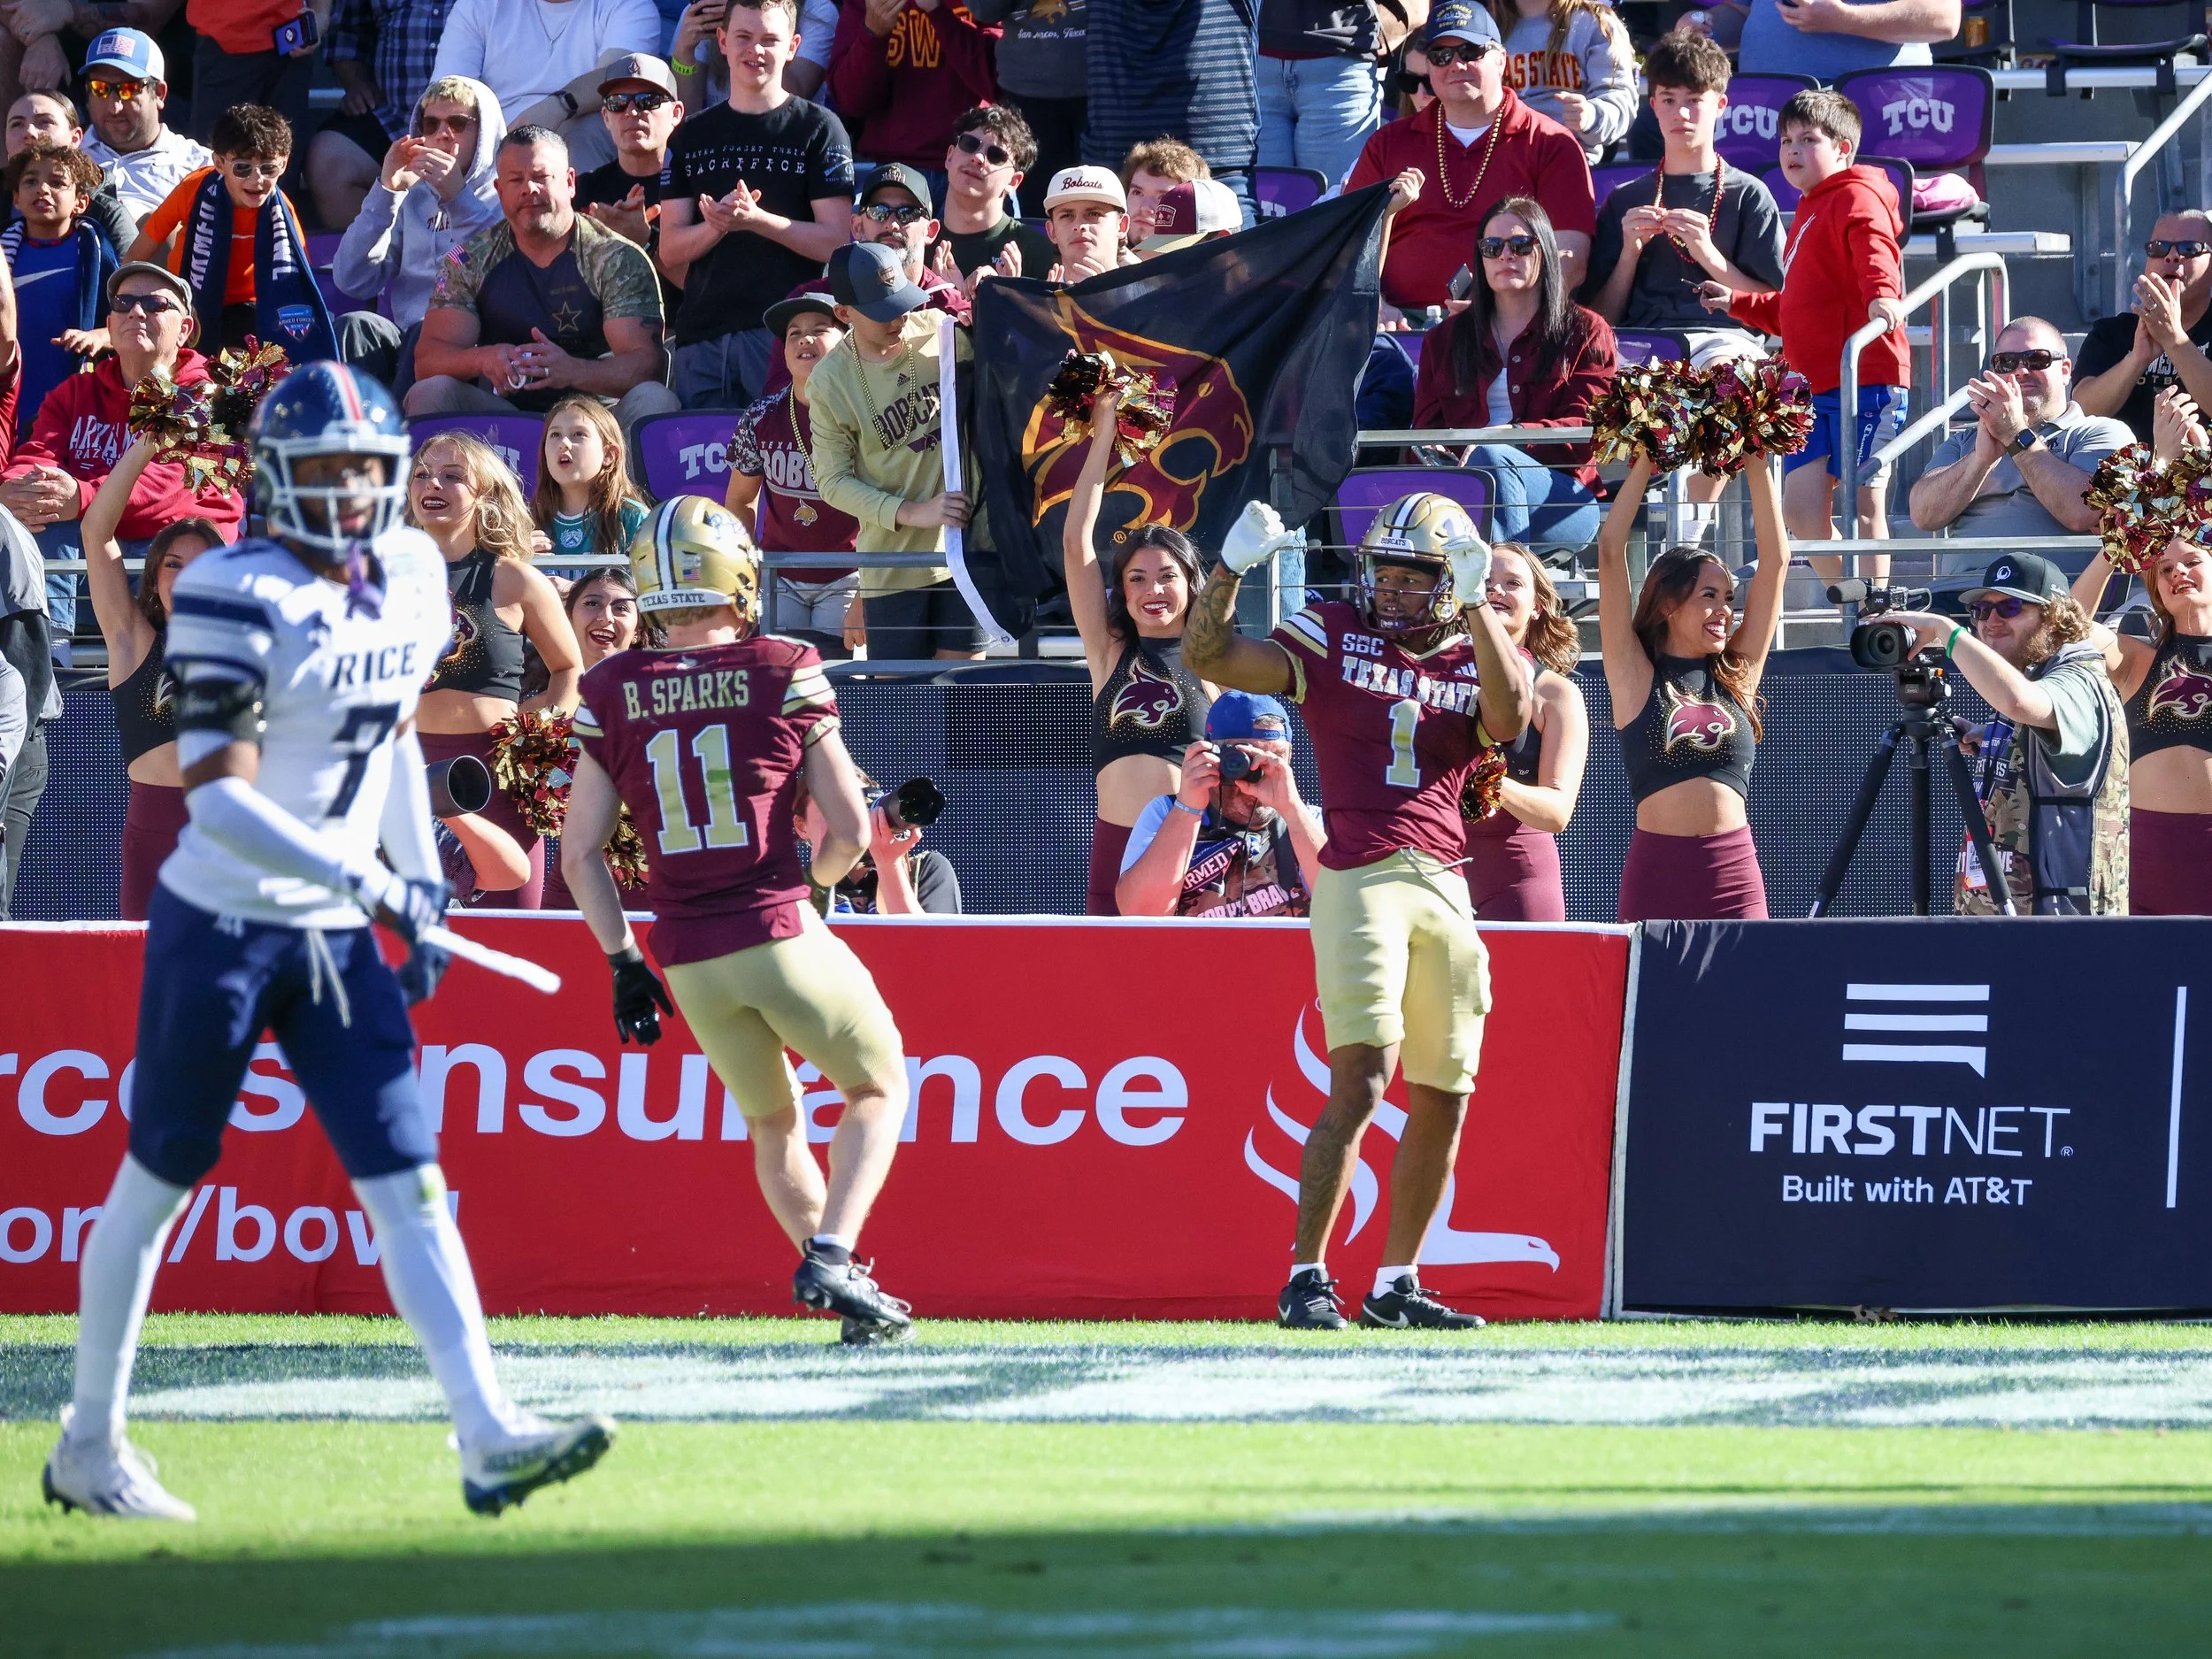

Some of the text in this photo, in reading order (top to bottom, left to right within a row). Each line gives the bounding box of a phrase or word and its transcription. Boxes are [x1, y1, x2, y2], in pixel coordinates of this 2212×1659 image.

[1063, 27, 1087, 39] Texa
[1882, 98, 1955, 136] TCU
[685, 157, 806, 177] SACRIFICE
[1061, 176, 1104, 191] Bobcats
[872, 381, 941, 451] BOBCAT
[679, 442, 733, 480] TC
[760, 441, 794, 450] TEXA
[1380, 537, 1407, 546] BOBCATS
[641, 593, 706, 608] TEXAS STATE
[1341, 633, 1385, 657] SBC
[329, 641, 418, 689] RICE
[1341, 655, 1416, 697] TEXAS
[622, 668, 750, 721] B. SPARKS
[325, 700, 402, 818] 7
[1385, 698, 1422, 789] 1
[645, 723, 749, 856] 11
[1781, 1174, 2033, 1206] Built with AT&T
